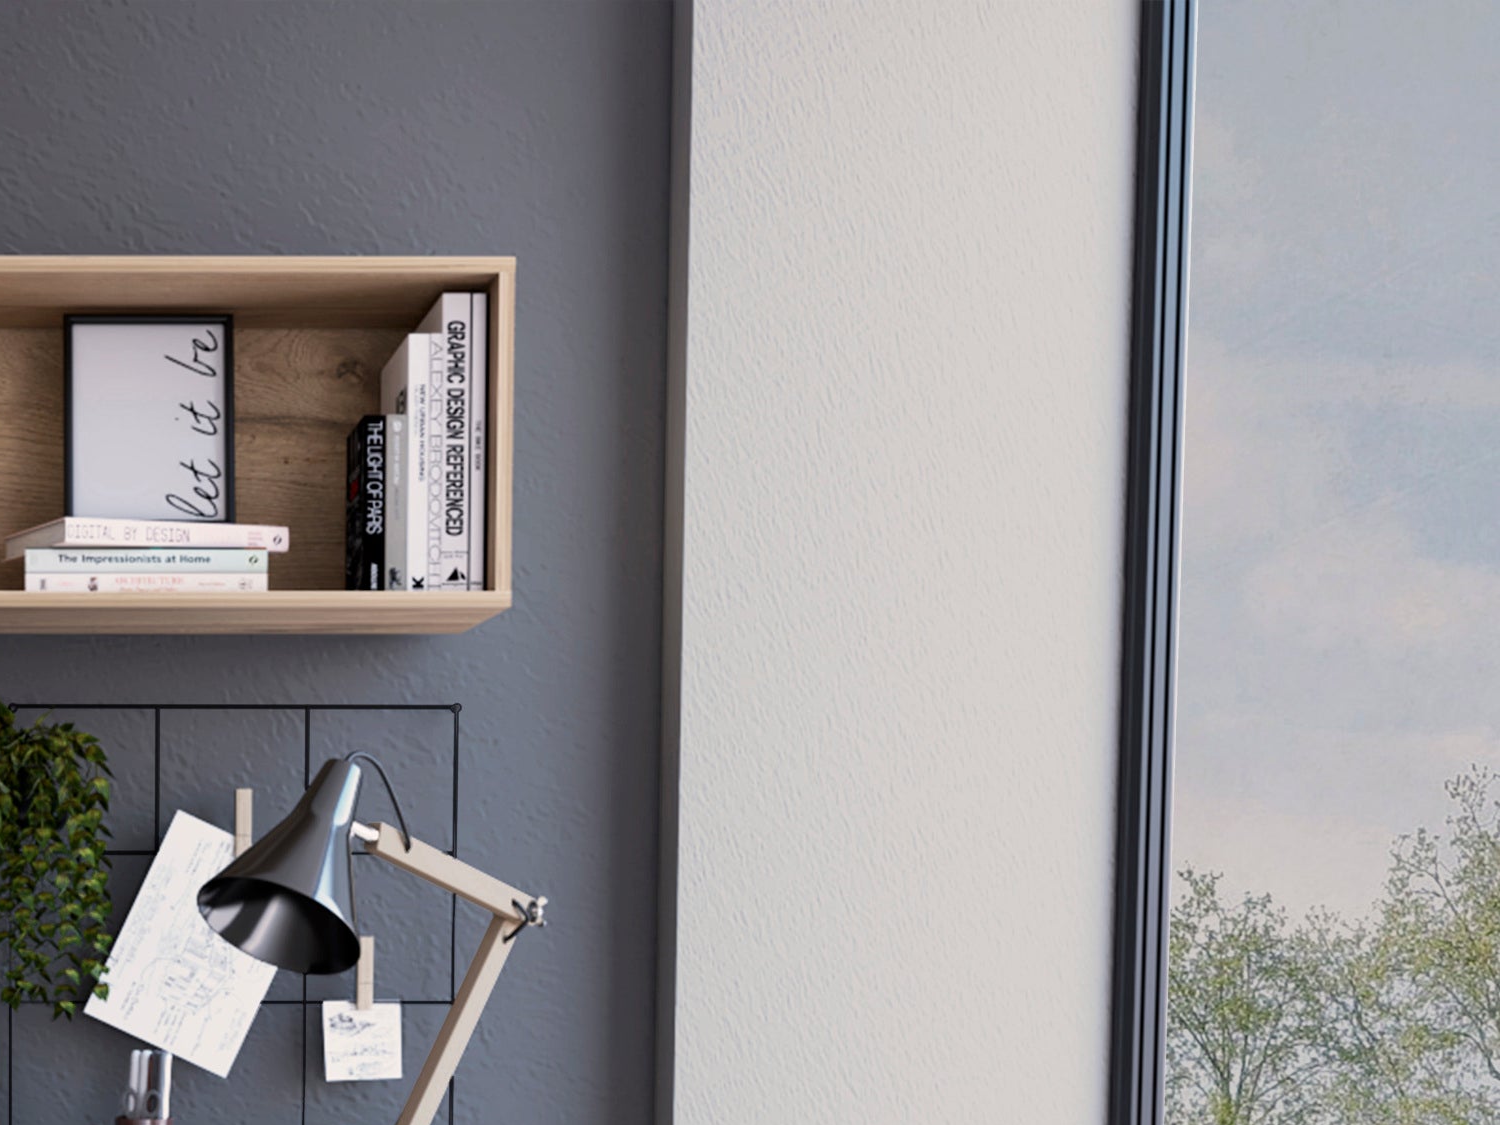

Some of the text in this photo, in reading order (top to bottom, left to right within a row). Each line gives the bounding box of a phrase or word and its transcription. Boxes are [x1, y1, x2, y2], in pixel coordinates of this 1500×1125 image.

[164, 329, 219, 378] be
[447, 320, 466, 384] GRAPHIC
[429, 341, 443, 426] ALEXEY
[175, 400, 221, 436] it
[446, 388, 465, 440] DESIGN
[165, 459, 222, 519] let
[445, 444, 464, 537] REFERENCED
[67, 524, 190, 542] DIGITAL BY DESIGN
[366, 500, 383, 535] PARIS
[58, 554, 211, 565] The Impressionists at Home
